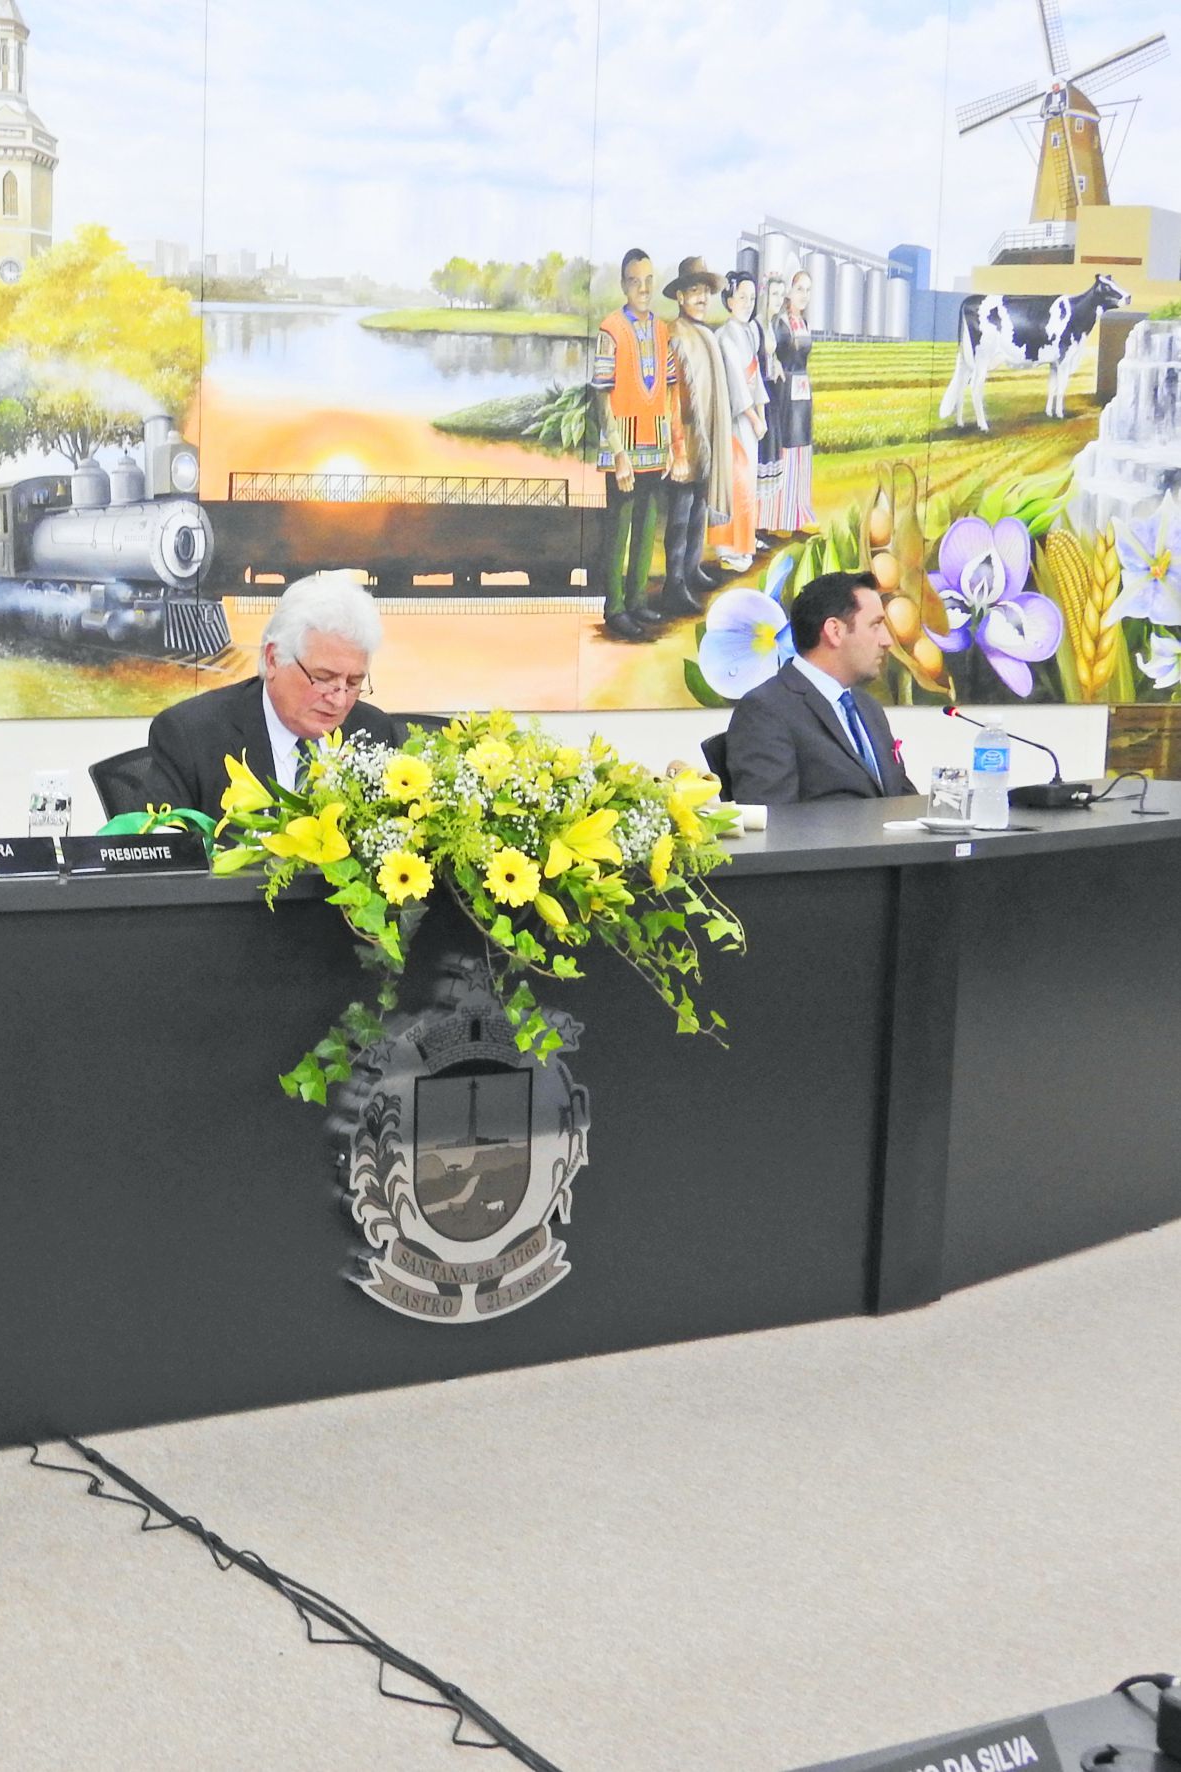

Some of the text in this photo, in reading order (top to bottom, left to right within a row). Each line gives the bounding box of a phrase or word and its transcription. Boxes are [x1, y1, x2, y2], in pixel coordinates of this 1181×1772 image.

[100, 846, 172, 861] PRESIDENTE
[390, 1285, 453, 1315] CASTRO
[977, 1735, 1038, 1772] SILVA
